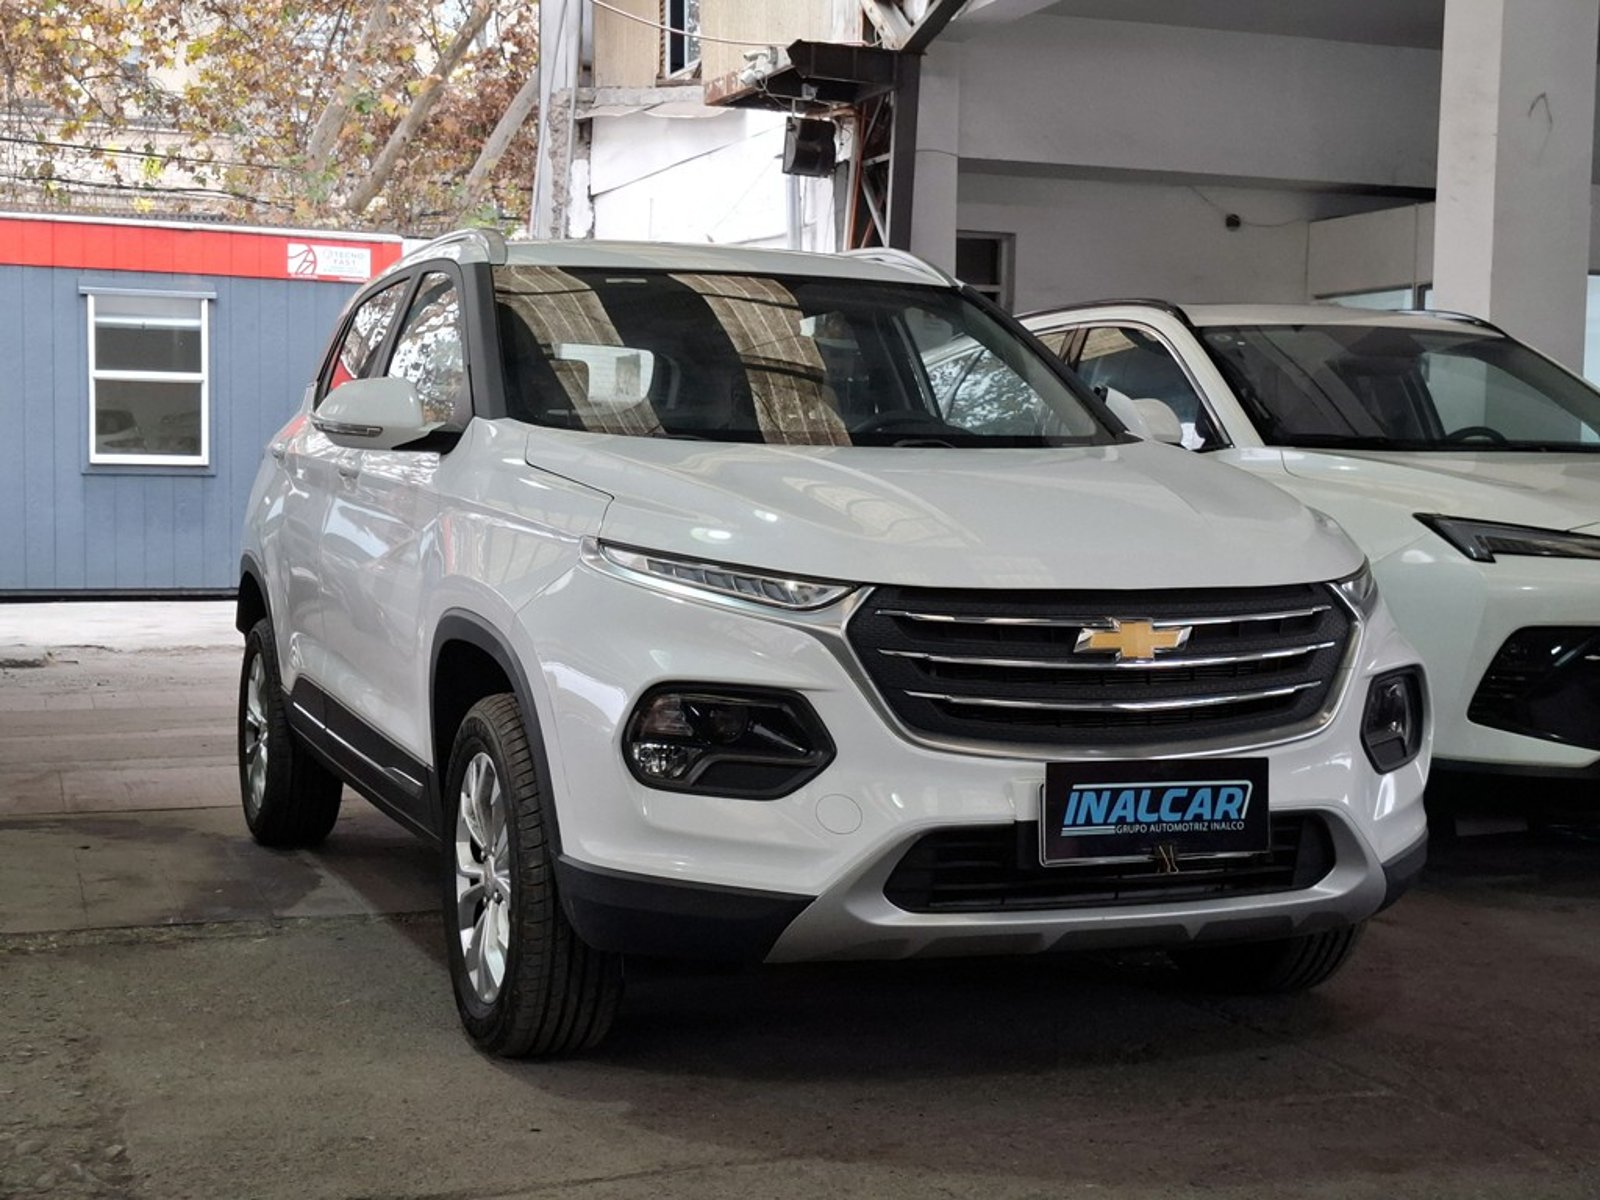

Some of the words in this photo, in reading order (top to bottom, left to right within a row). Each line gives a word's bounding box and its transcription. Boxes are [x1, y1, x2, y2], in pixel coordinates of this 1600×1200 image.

[1063, 787, 1244, 825] INALCAR
[1116, 824, 1148, 834] GRUPO
[1149, 822, 1208, 833] AUTOMOTRIZ
[1210, 821, 1245, 831] INALCO
